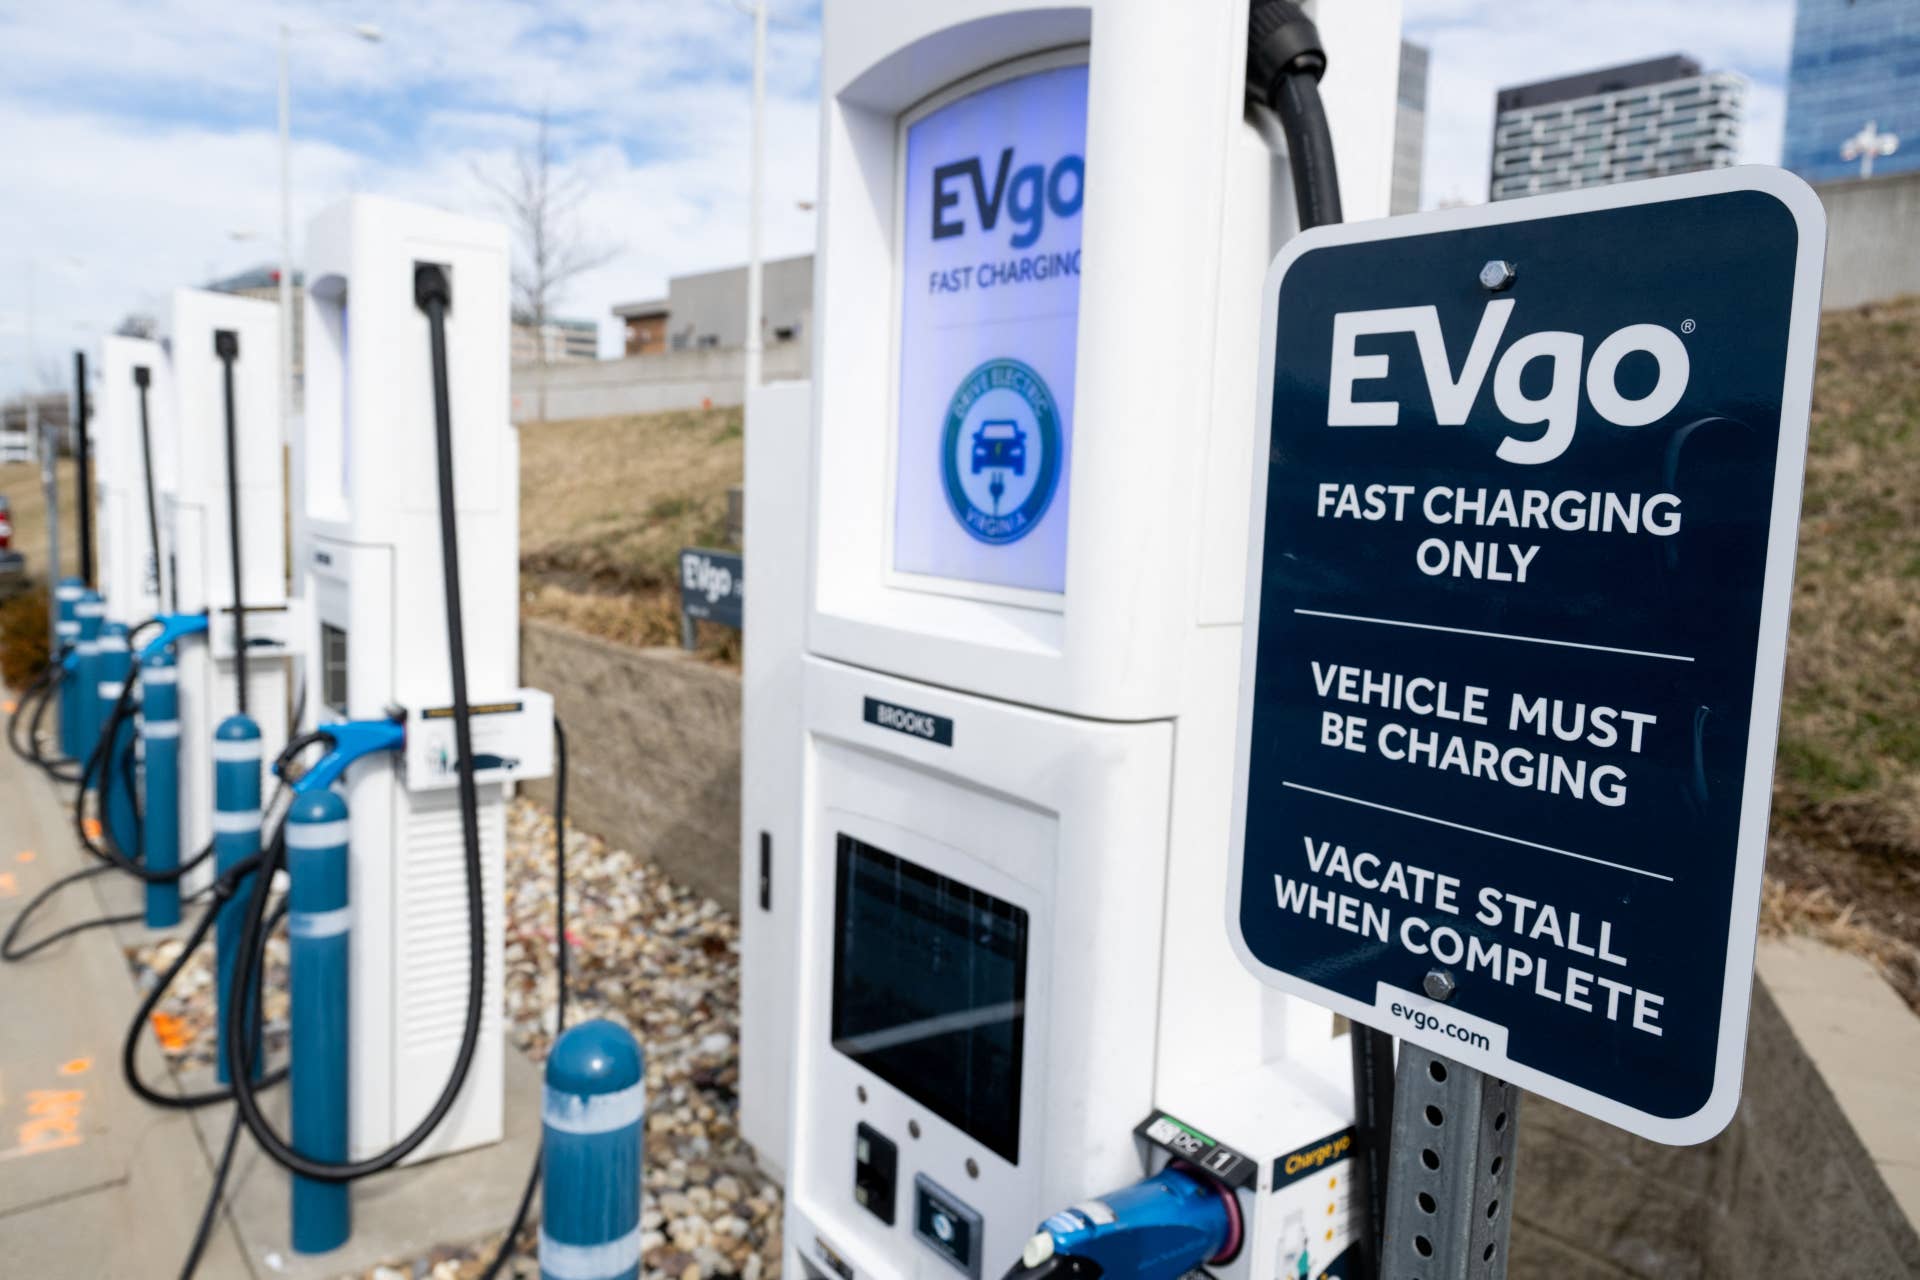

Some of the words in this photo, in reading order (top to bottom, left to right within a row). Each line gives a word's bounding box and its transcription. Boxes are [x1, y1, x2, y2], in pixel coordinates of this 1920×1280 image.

[931, 146, 1085, 249] EVgo
[929, 266, 973, 294] FAST
[1327, 298, 1690, 465] EVgo
[1317, 483, 1415, 521] FAST
[1423, 486, 1682, 536] CHARGING
[682, 553, 732, 602] EVgo
[1416, 538, 1540, 583] ONLY
[877, 704, 935, 738] BROOKS
[1311, 661, 1490, 725] VEHICLE
[1508, 693, 1657, 753] MUST
[1321, 711, 1367, 753] BE
[1378, 723, 1628, 807] CHARGING
[1304, 836, 1461, 915] VACATE
[1475, 887, 1628, 967] STALL
[1274, 874, 1391, 944] WHEN
[1400, 917, 1664, 1037] COMPLETE
[1391, 1002, 1490, 1051] evgo.com
[1213, 1152, 1231, 1170] 1
[1285, 1142, 1333, 1175] Charge
